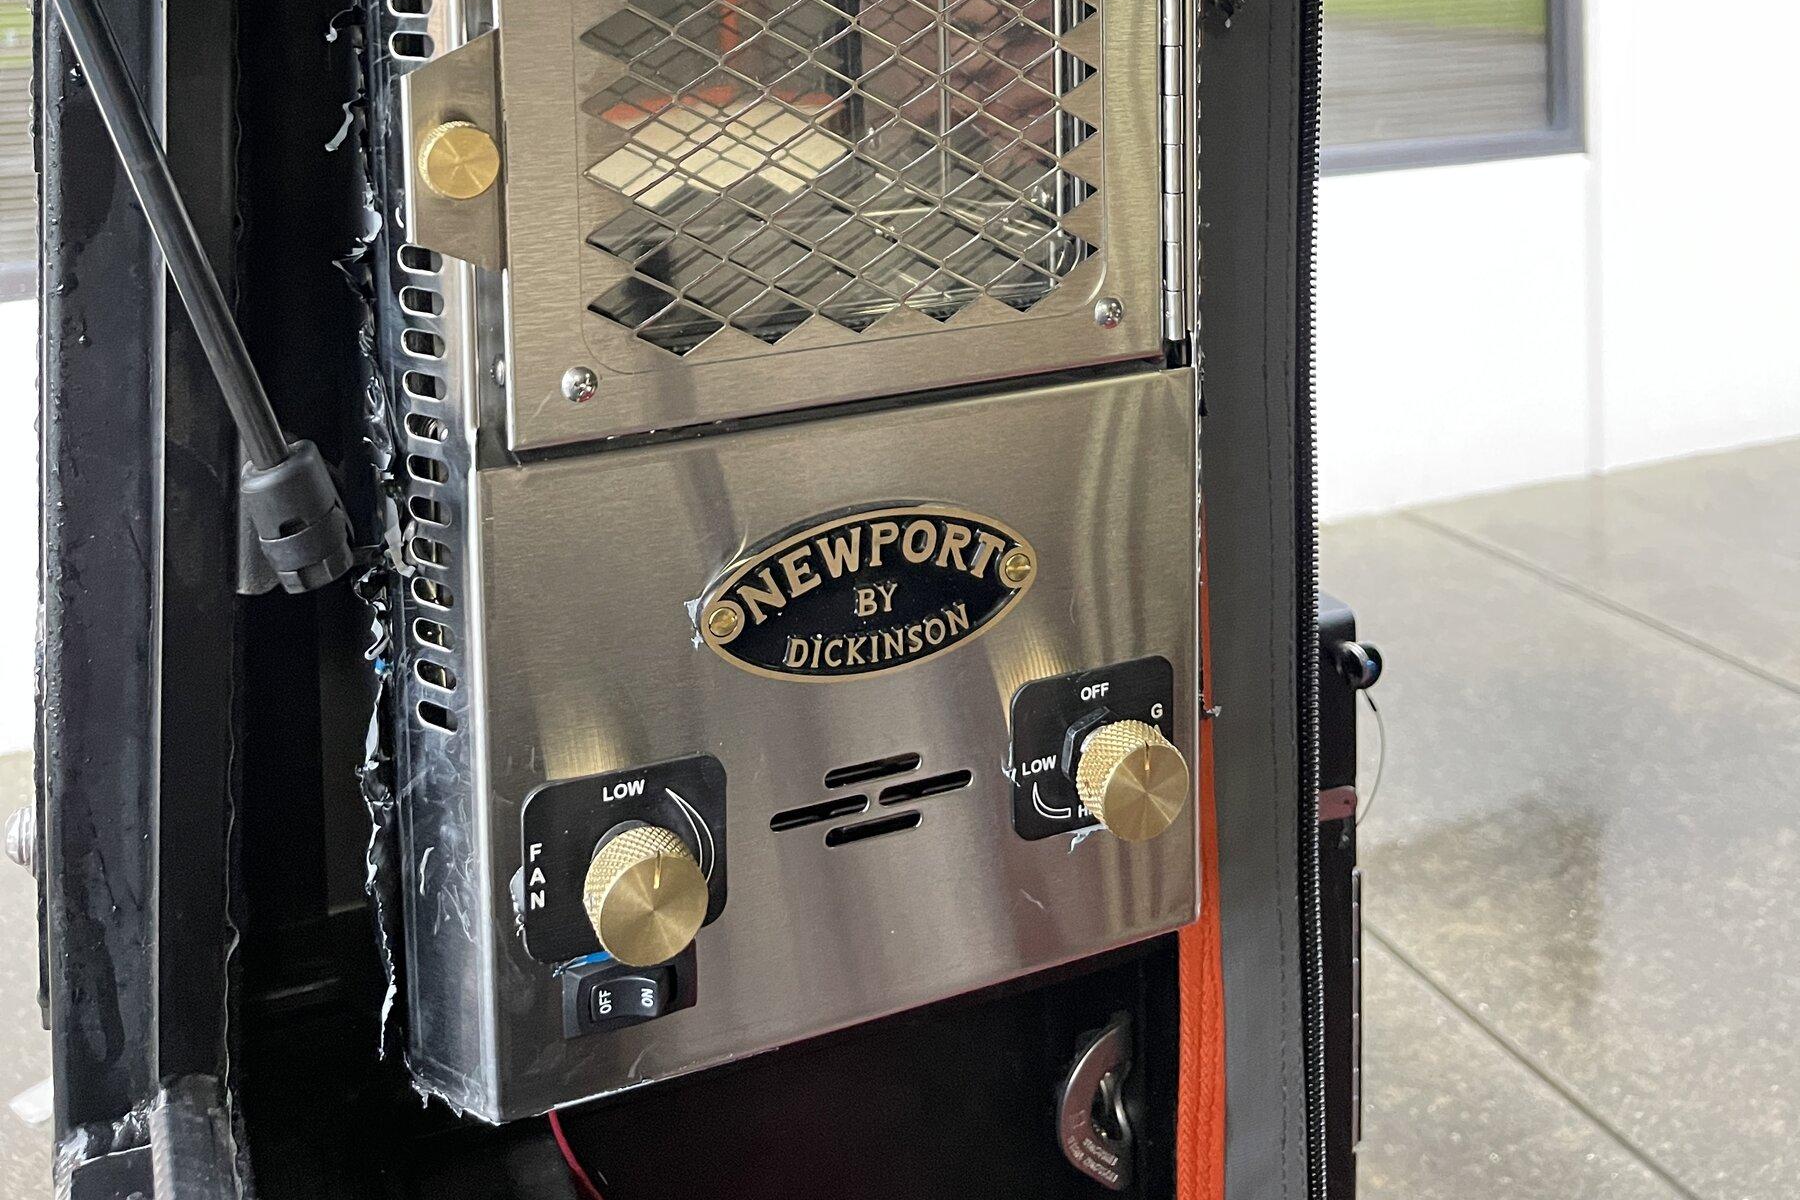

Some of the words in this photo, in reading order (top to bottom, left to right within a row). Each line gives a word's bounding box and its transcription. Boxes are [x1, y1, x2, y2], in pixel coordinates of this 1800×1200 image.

[737, 520, 1005, 626] NEWPORT
[854, 581, 897, 617] BY
[783, 602, 971, 669] DICKINSON
[1080, 682, 1110, 701] OFF
[1022, 755, 1057, 776] LOW
[602, 779, 646, 802] LOW
[529, 843, 546, 910] FAN
[599, 990, 612, 1014] OFF
[641, 988, 654, 1007] ON
